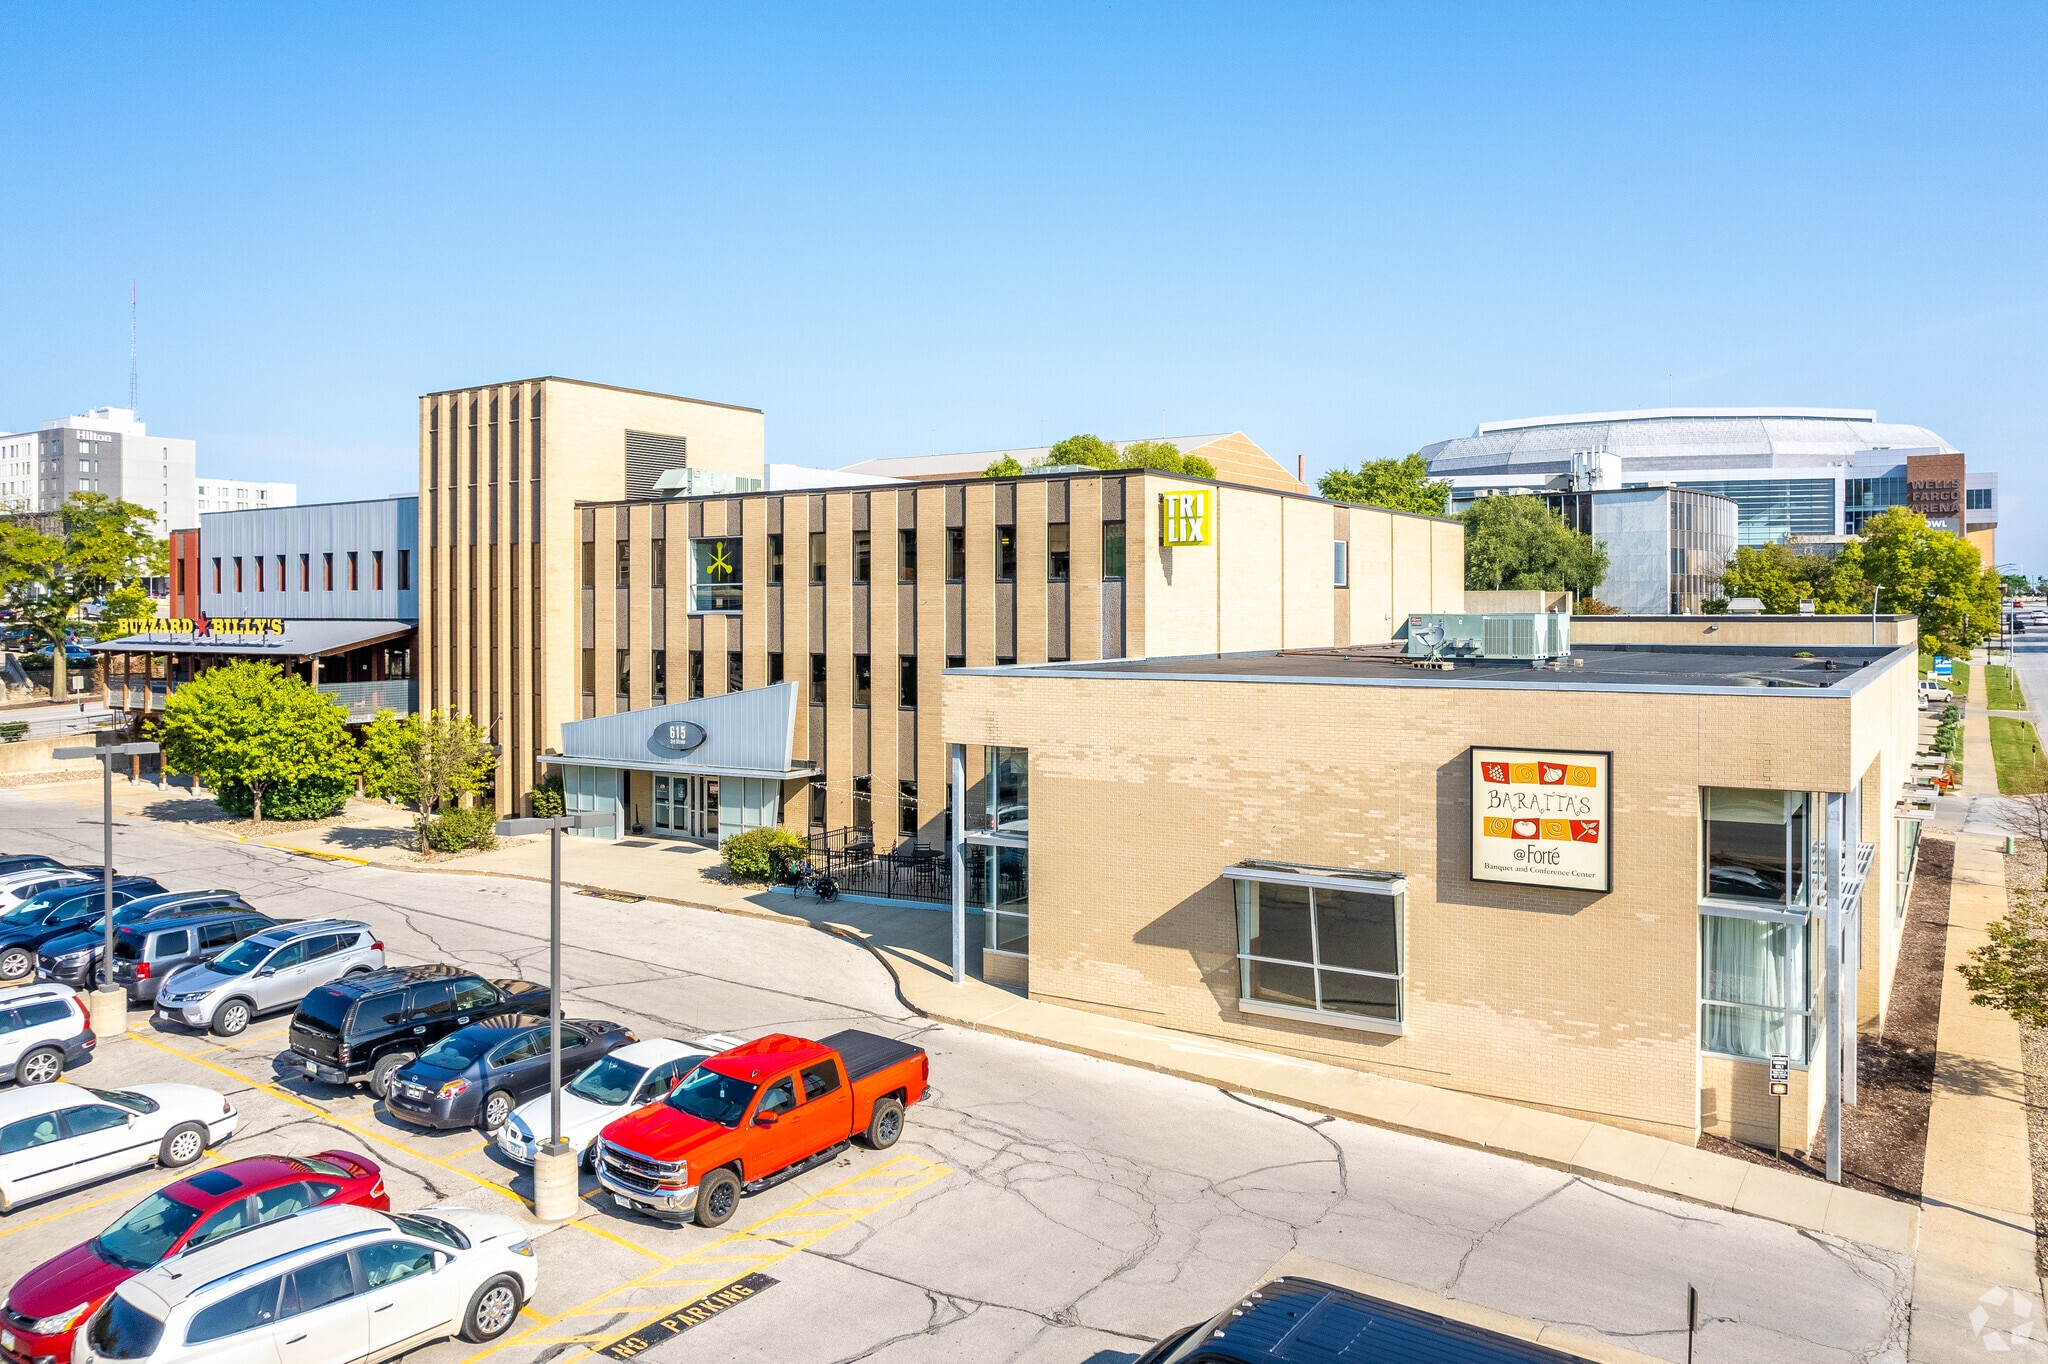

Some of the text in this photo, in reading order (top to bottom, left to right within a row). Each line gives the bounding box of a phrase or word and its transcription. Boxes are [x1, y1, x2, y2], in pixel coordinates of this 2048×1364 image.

[76, 430, 112, 442] Hilton
[1911, 479, 1960, 489] WELLS
[1912, 490, 1960, 501] FARGO
[1165, 494, 1204, 517] TRI
[1911, 502, 1960, 513] ARENA
[1168, 518, 1204, 542] LIX
[1925, 520, 1947, 528] OWL
[118, 618, 284, 635] BUZZARD BILLY'S
[669, 725, 686, 739] 615
[1487, 789, 1591, 816] BARATTA'S
[1484, 862, 1513, 872] Banquet
[1529, 866, 1570, 877] Conference
[1571, 869, 1596, 878] Center
[611, 1284, 755, 1358] NO PARKING
